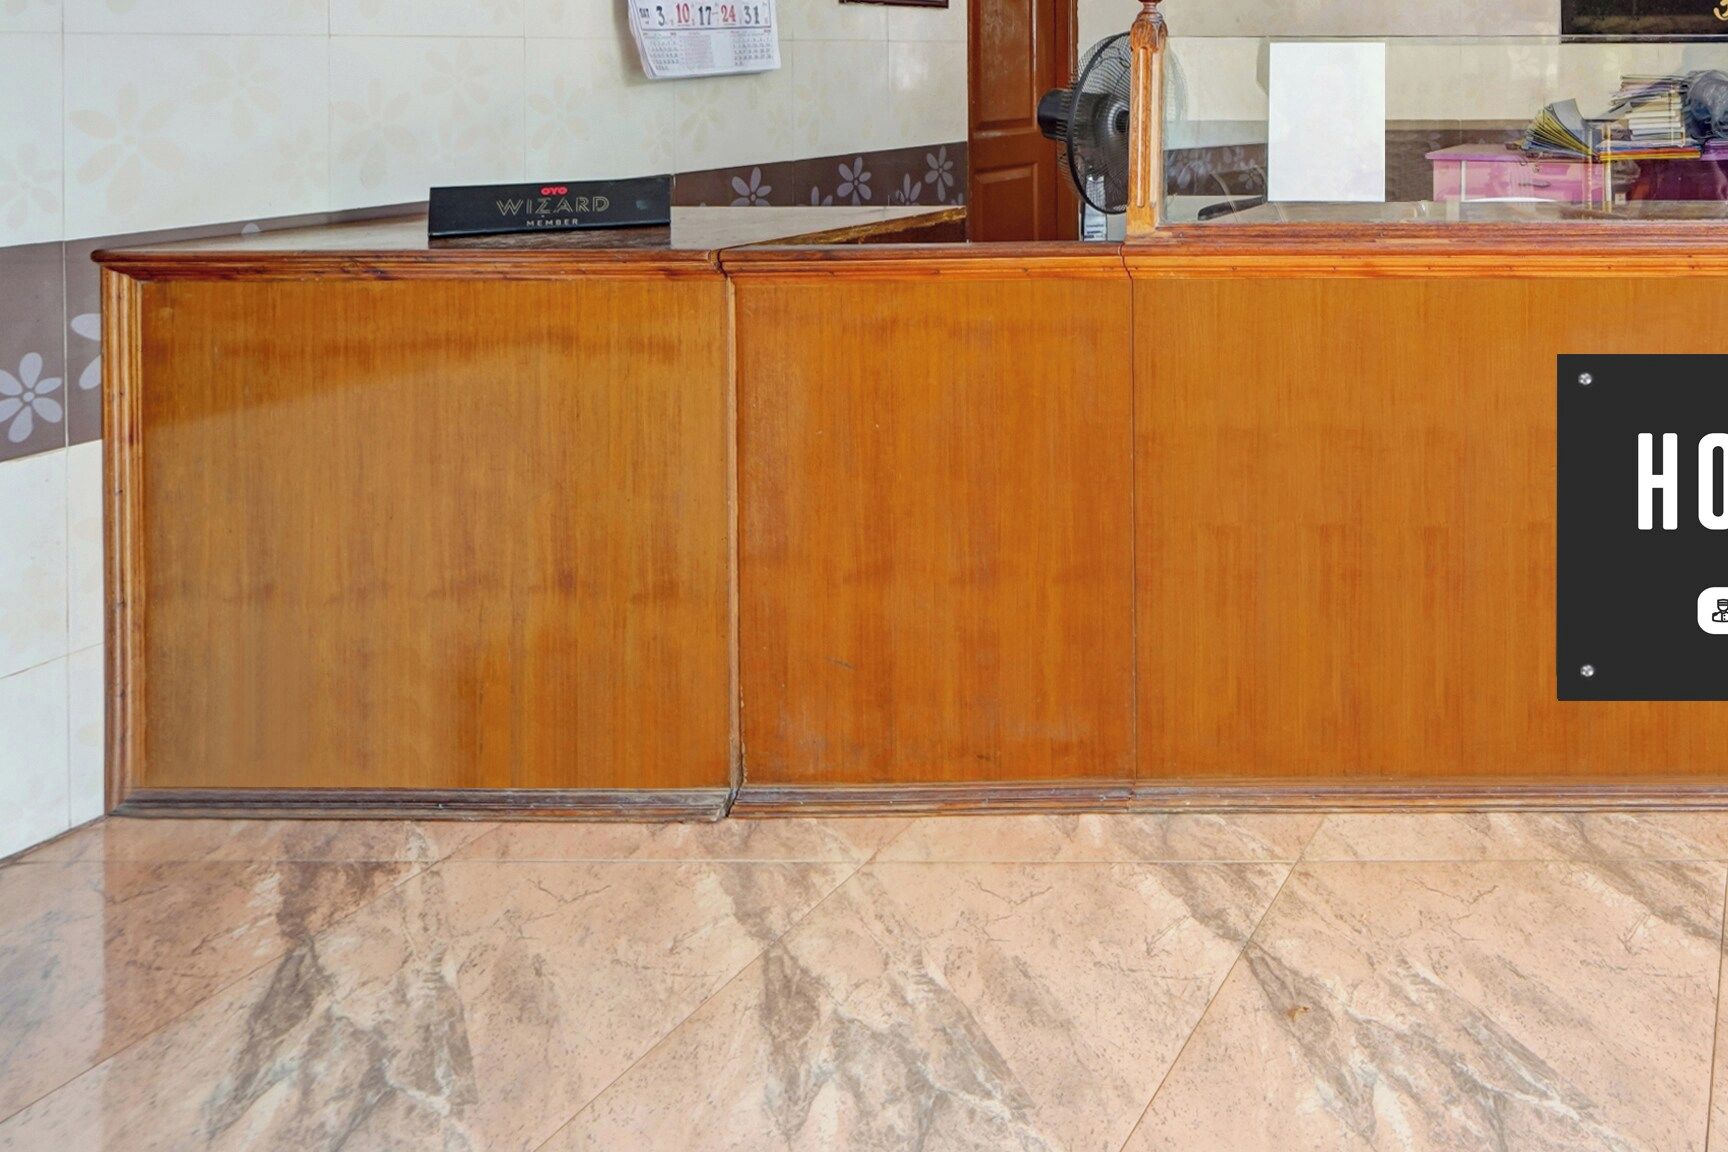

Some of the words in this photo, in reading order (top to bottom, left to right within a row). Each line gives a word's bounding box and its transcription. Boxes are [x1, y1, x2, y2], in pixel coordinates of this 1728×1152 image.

[656, 6, 665, 26] 3
[676, 3, 690, 24] 10
[698, 6, 712, 26] 17
[721, 4, 736, 22] 24
[744, 5, 760, 24] 31
[541, 186, 568, 196] OYO
[496, 196, 610, 216] WIZARD
[526, 218, 578, 227] MEMBER
